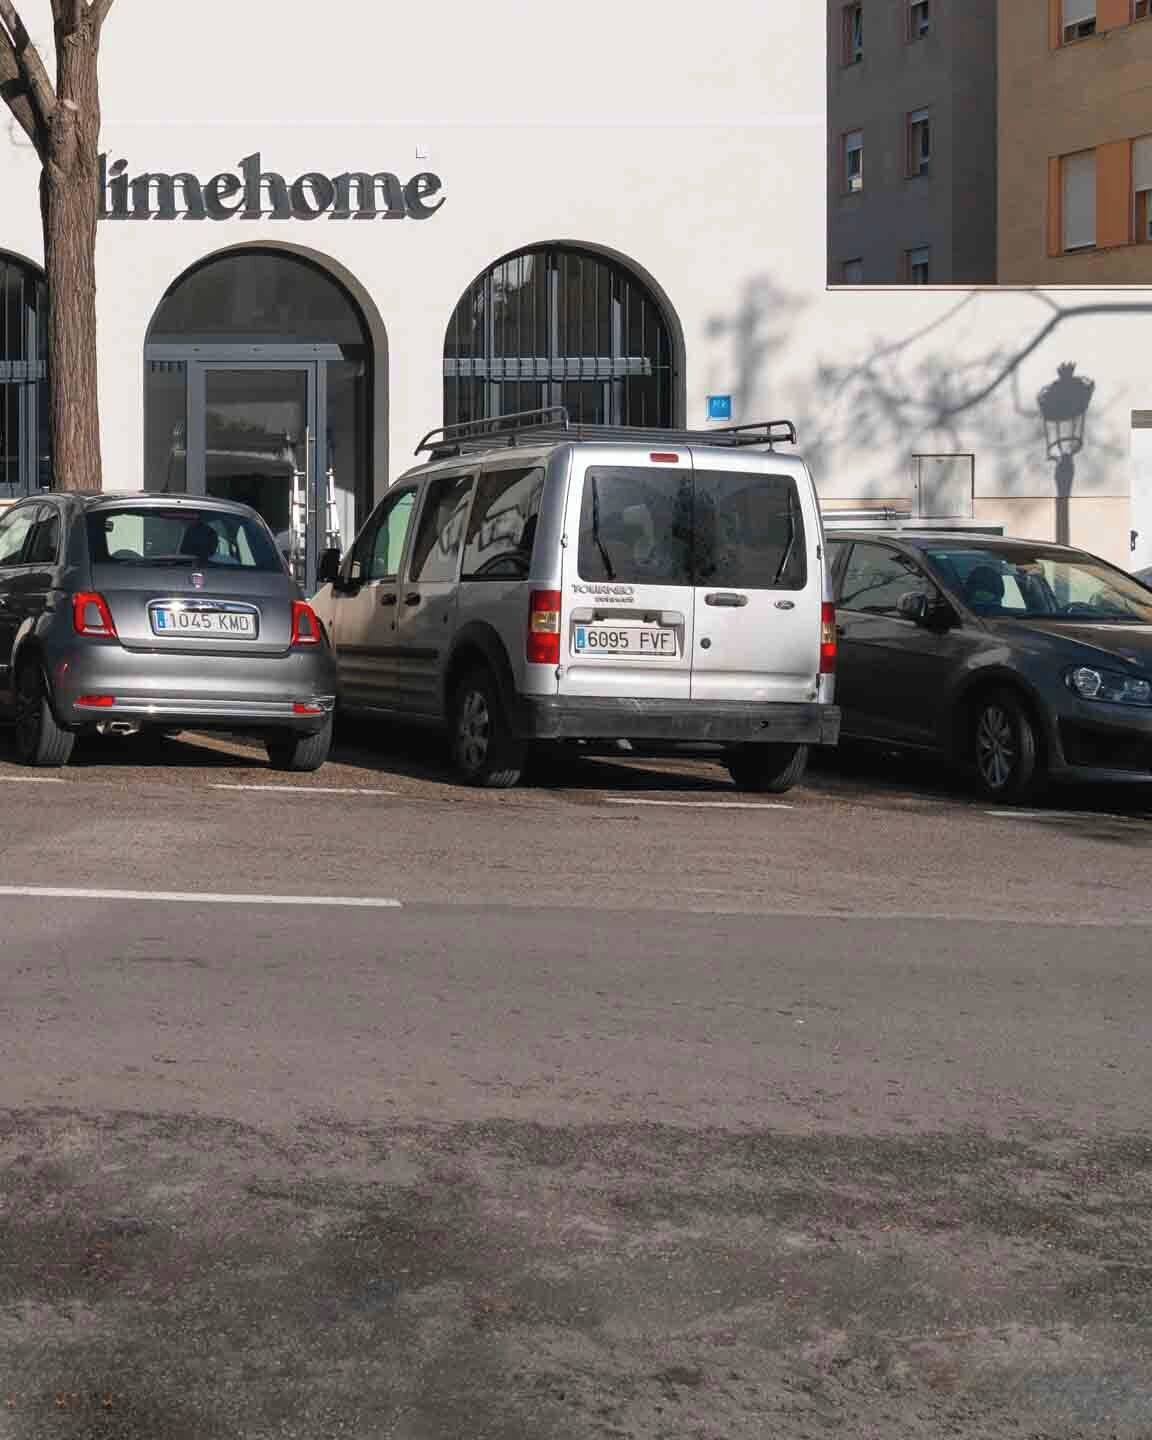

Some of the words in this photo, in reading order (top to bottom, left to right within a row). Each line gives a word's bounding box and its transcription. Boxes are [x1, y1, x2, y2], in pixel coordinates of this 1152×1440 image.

[168, 613, 212, 629] 1045
[218, 614, 250, 631] KMD
[587, 631, 630, 648] 6095
[639, 631, 672, 649] FVF
